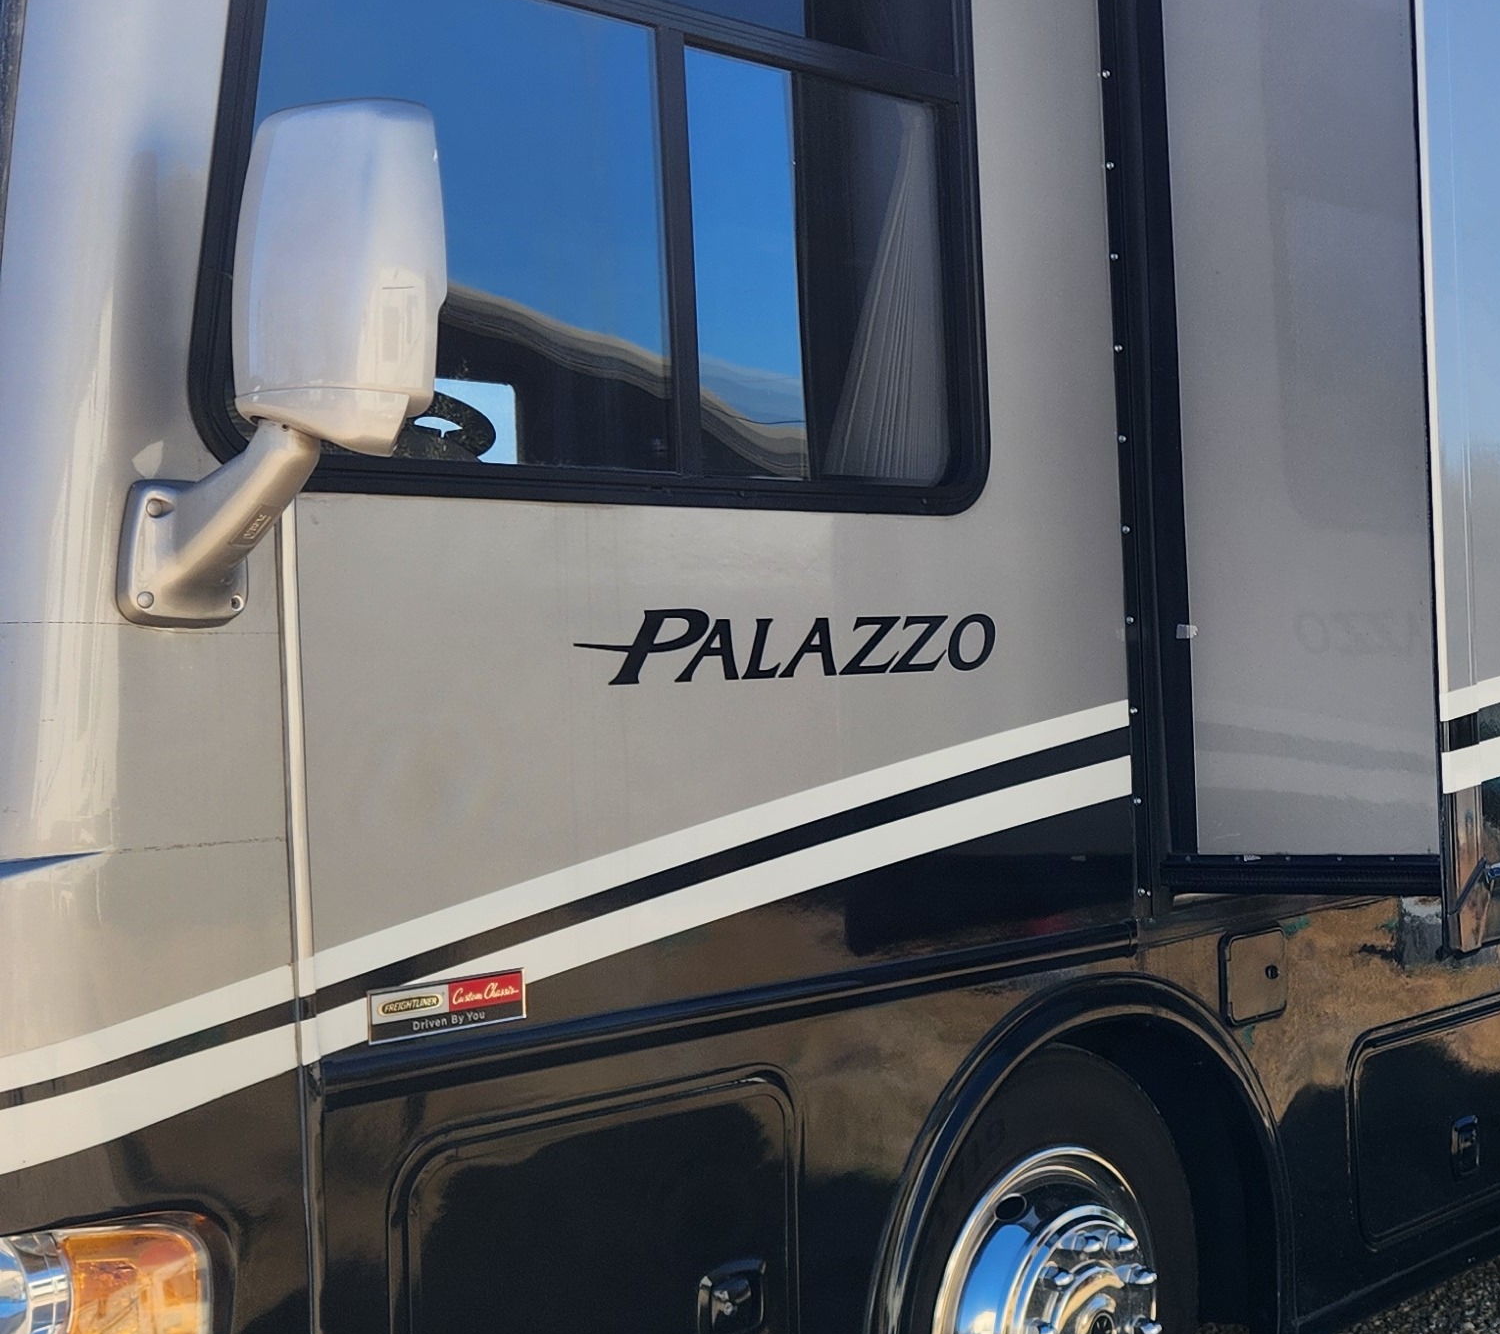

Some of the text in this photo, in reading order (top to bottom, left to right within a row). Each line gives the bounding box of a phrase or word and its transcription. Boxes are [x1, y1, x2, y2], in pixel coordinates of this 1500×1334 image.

[573, 608, 997, 686] PALAZZO
[453, 982, 519, 1005] Custom Chassis
[384, 997, 438, 1013] FREIGHTLINER
[412, 1011, 486, 1031] Driven By You
